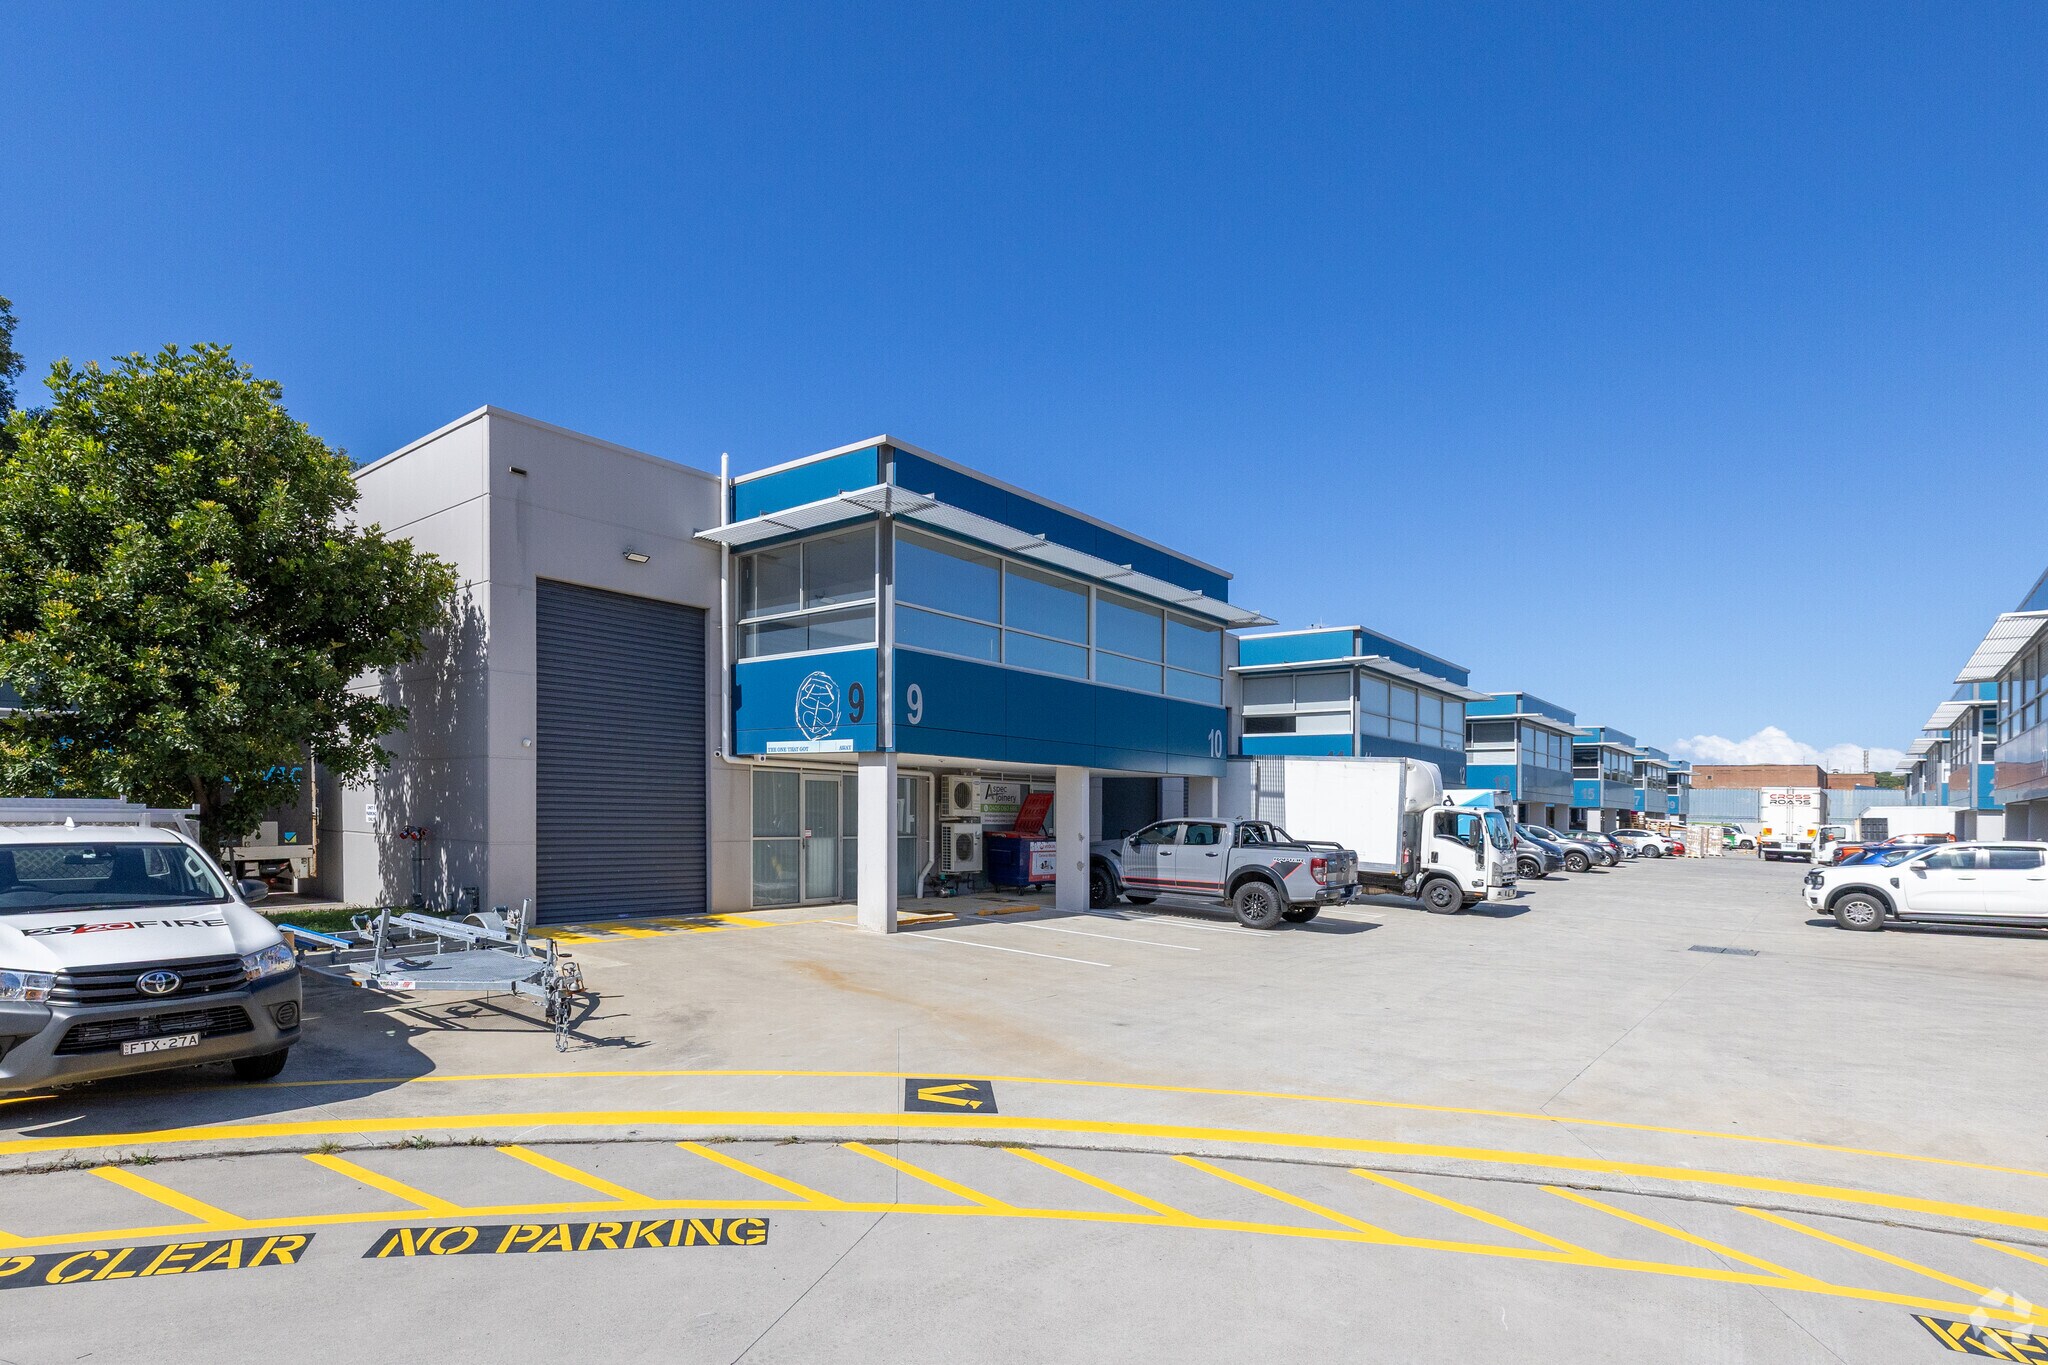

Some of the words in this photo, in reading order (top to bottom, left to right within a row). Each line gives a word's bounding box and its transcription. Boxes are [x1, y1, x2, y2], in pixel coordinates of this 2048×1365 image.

[848, 682, 864, 723] 9
[907, 683, 923, 724] 9
[1208, 728, 1222, 758] 10
[1582, 787, 1595, 799] 15
[1633, 795, 1640, 806] 7
[377, 1227, 478, 1258] NO
[496, 1218, 766, 1253] PARKING
[45, 1235, 307, 1284] CLEAR
